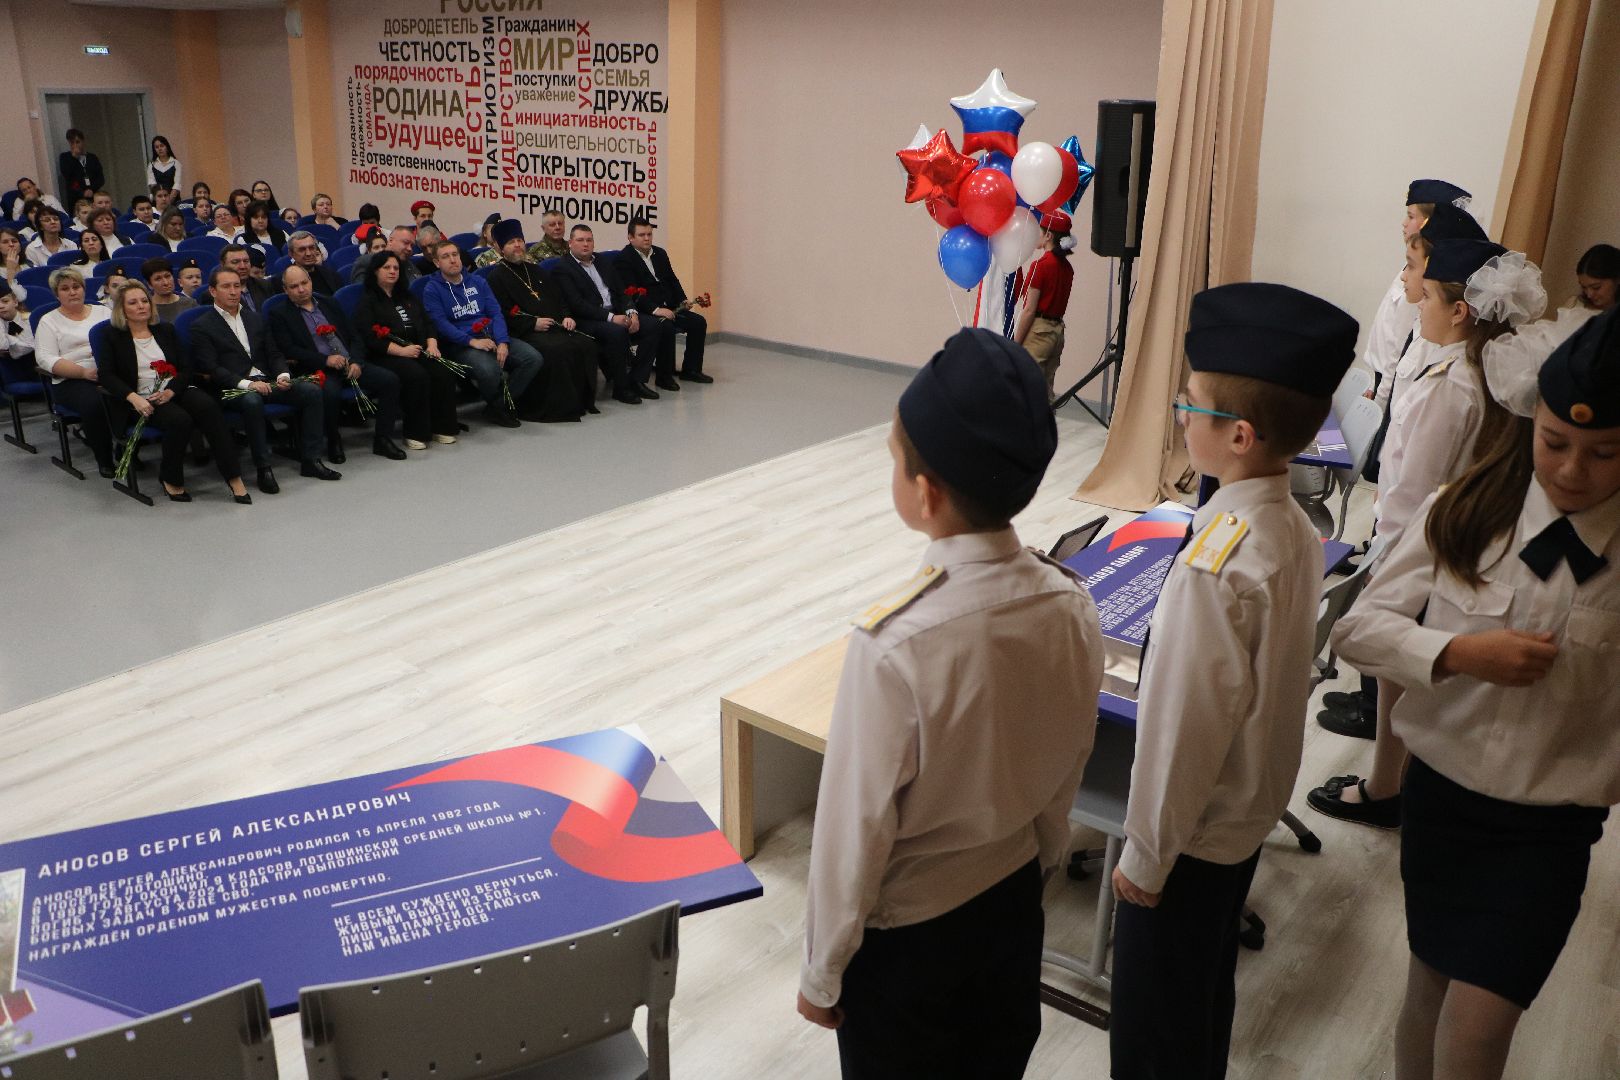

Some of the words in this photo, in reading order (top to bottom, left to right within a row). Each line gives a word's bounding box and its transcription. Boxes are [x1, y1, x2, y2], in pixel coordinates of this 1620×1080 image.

[383, 17, 478, 37] ДОБРОДЕТЕЛЬ
[497, 16, 576, 35] Гражданин
[379, 41, 480, 63] ЧЕСТНОСТЬ
[513, 38, 575, 71] МИР
[576, 20, 592, 109] УСПЕХ
[593, 43, 658, 66] ДОБРО
[354, 65, 464, 84] порядочность
[514, 74, 576, 90] поступки
[594, 68, 650, 87] СЕМЬЯ
[373, 86, 465, 120] РОДИНА
[482, 16, 498, 180] ПАТРИОТИЗМ
[514, 89, 576, 104] уважение
[375, 115, 466, 150] Будущее
[465, 65, 483, 178] ЧЕСТЬ
[499, 38, 516, 202] ЛИДЕРСТВО
[515, 112, 646, 131] инициативность
[516, 132, 646, 154] решительность
[366, 152, 466, 174] ответсвенность
[516, 153, 646, 183] ОТКРЫТОСТЬ
[349, 166, 499, 199] любознательность
[517, 175, 646, 199] компетентность
[38, 848, 128, 879] АНОСОВ
[140, 828, 222, 857] СЕРГЕЙ
[232, 791, 412, 839] АЛЕКСАНДРОВИЧ
[33, 886, 93, 906] АНОСОВ
[99, 872, 154, 892] СЕРГЕЙ
[160, 846, 282, 879] АЛЕКСАНДРОВИЧ
[287, 832, 350, 853] РОДИЛСЯ
[355, 828, 370, 838] 15
[376, 816, 426, 834] АПРЕЛЯ
[432, 809, 463, 822] 1982
[466, 800, 501, 815] ГОДА
[93, 895, 133, 911] ГОДУ
[140, 879, 208, 901] ОКОНЧИЛ
[228, 860, 293, 882] КЛАССОВ
[299, 837, 399, 867] ЛОТОШИНСКОЙ
[403, 824, 463, 845] СРЕДНЕЙ
[466, 813, 514, 831] ШКОЛЫ
[31, 916, 82, 934] ПОГИБ
[91, 910, 107, 921] 17
[114, 894, 182, 917] АВГУСТА
[188, 884, 225, 900] 2024
[230, 876, 269, 891] ГОДА
[275, 868, 302, 881] ПРИ
[307, 847, 400, 875] ВЫПОЛНЕНИИ
[136, 912, 209, 937] ОРДЕНОМ
[216, 893, 298, 919] МУЖЕСТВА
[303, 872, 391, 899] ПОСМЕРТНО.
[30, 922, 95, 946] БОЕВЫХ
[102, 908, 154, 929] ЗАДАЧ
[161, 905, 170, 916] В
[177, 895, 216, 912] ХОДЕ
[222, 888, 255, 902] СВО.
[334, 914, 352, 928] НЕ
[357, 904, 397, 921] ВСЕМ
[401, 888, 470, 911] СУЖДЕНО
[337, 913, 403, 937] ЖИВЫМИ
[408, 900, 457, 920] ВЫЙТИ
[461, 895, 480, 908] ИЗ
[341, 929, 382, 946] ЛИШЬ
[388, 925, 397, 935] В
[402, 909, 461, 932] ПАМЯТИ
[466, 890, 541, 916] ОСТАЮТСЯ
[342, 941, 375, 957] НАМ
[380, 927, 431, 948] ИМЕНА
[435, 913, 494, 934] ГЕРОЕВ.
